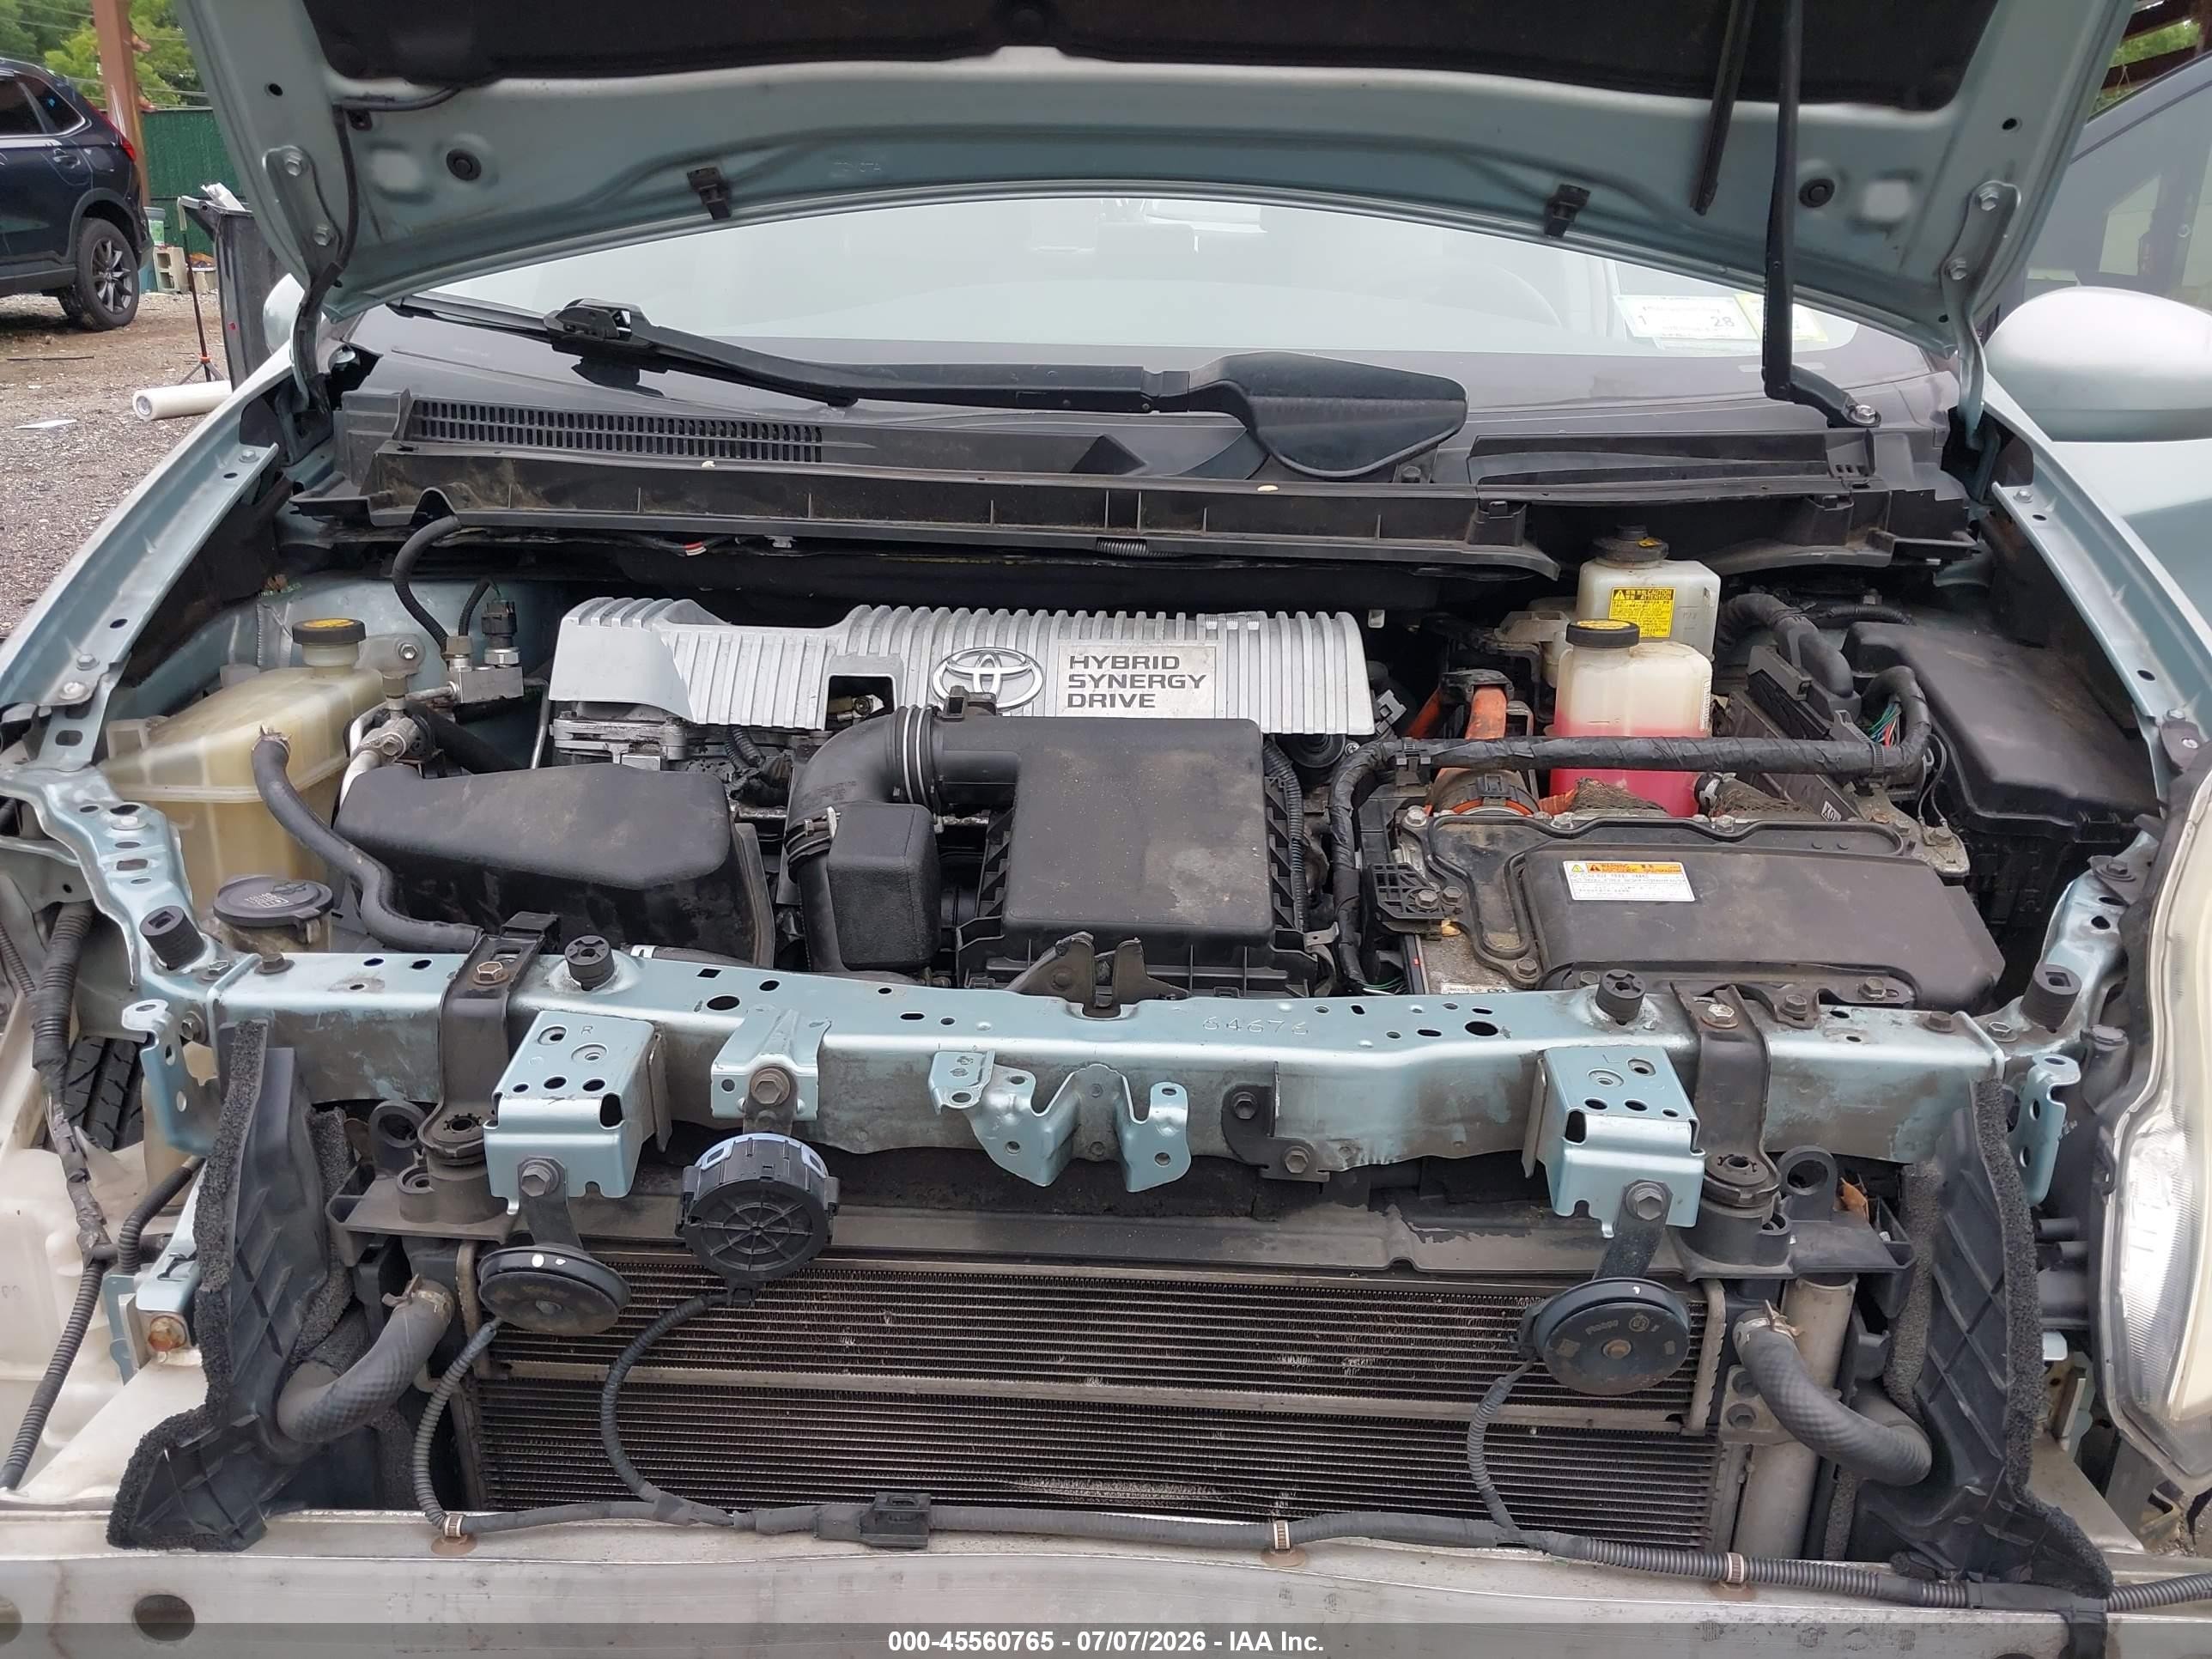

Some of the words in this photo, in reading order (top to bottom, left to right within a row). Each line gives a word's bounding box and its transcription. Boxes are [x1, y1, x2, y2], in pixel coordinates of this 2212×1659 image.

[1710, 315, 1735, 328] 28
[1069, 655, 1180, 670] HYBRID
[1067, 673, 1207, 690] SYNERGY
[1066, 693, 1157, 708] DRIVE
[580, 1025, 593, 1036] R
